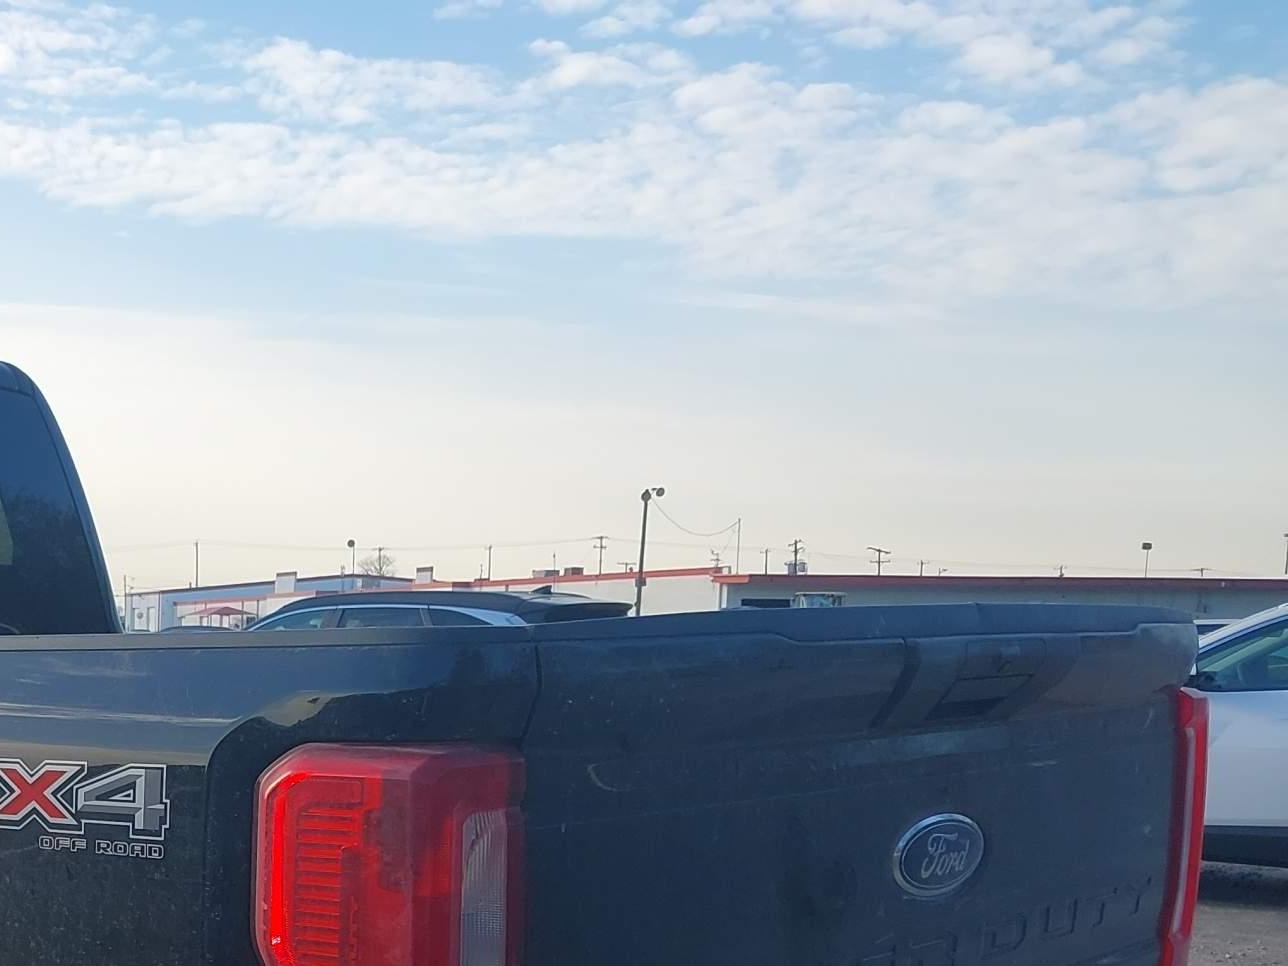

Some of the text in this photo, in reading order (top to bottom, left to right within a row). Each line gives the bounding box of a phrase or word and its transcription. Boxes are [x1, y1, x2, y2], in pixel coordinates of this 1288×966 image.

[39, 835, 165, 860] OFF ROAD
[921, 832, 970, 879] Ford
[979, 875, 1152, 960] DUTY
